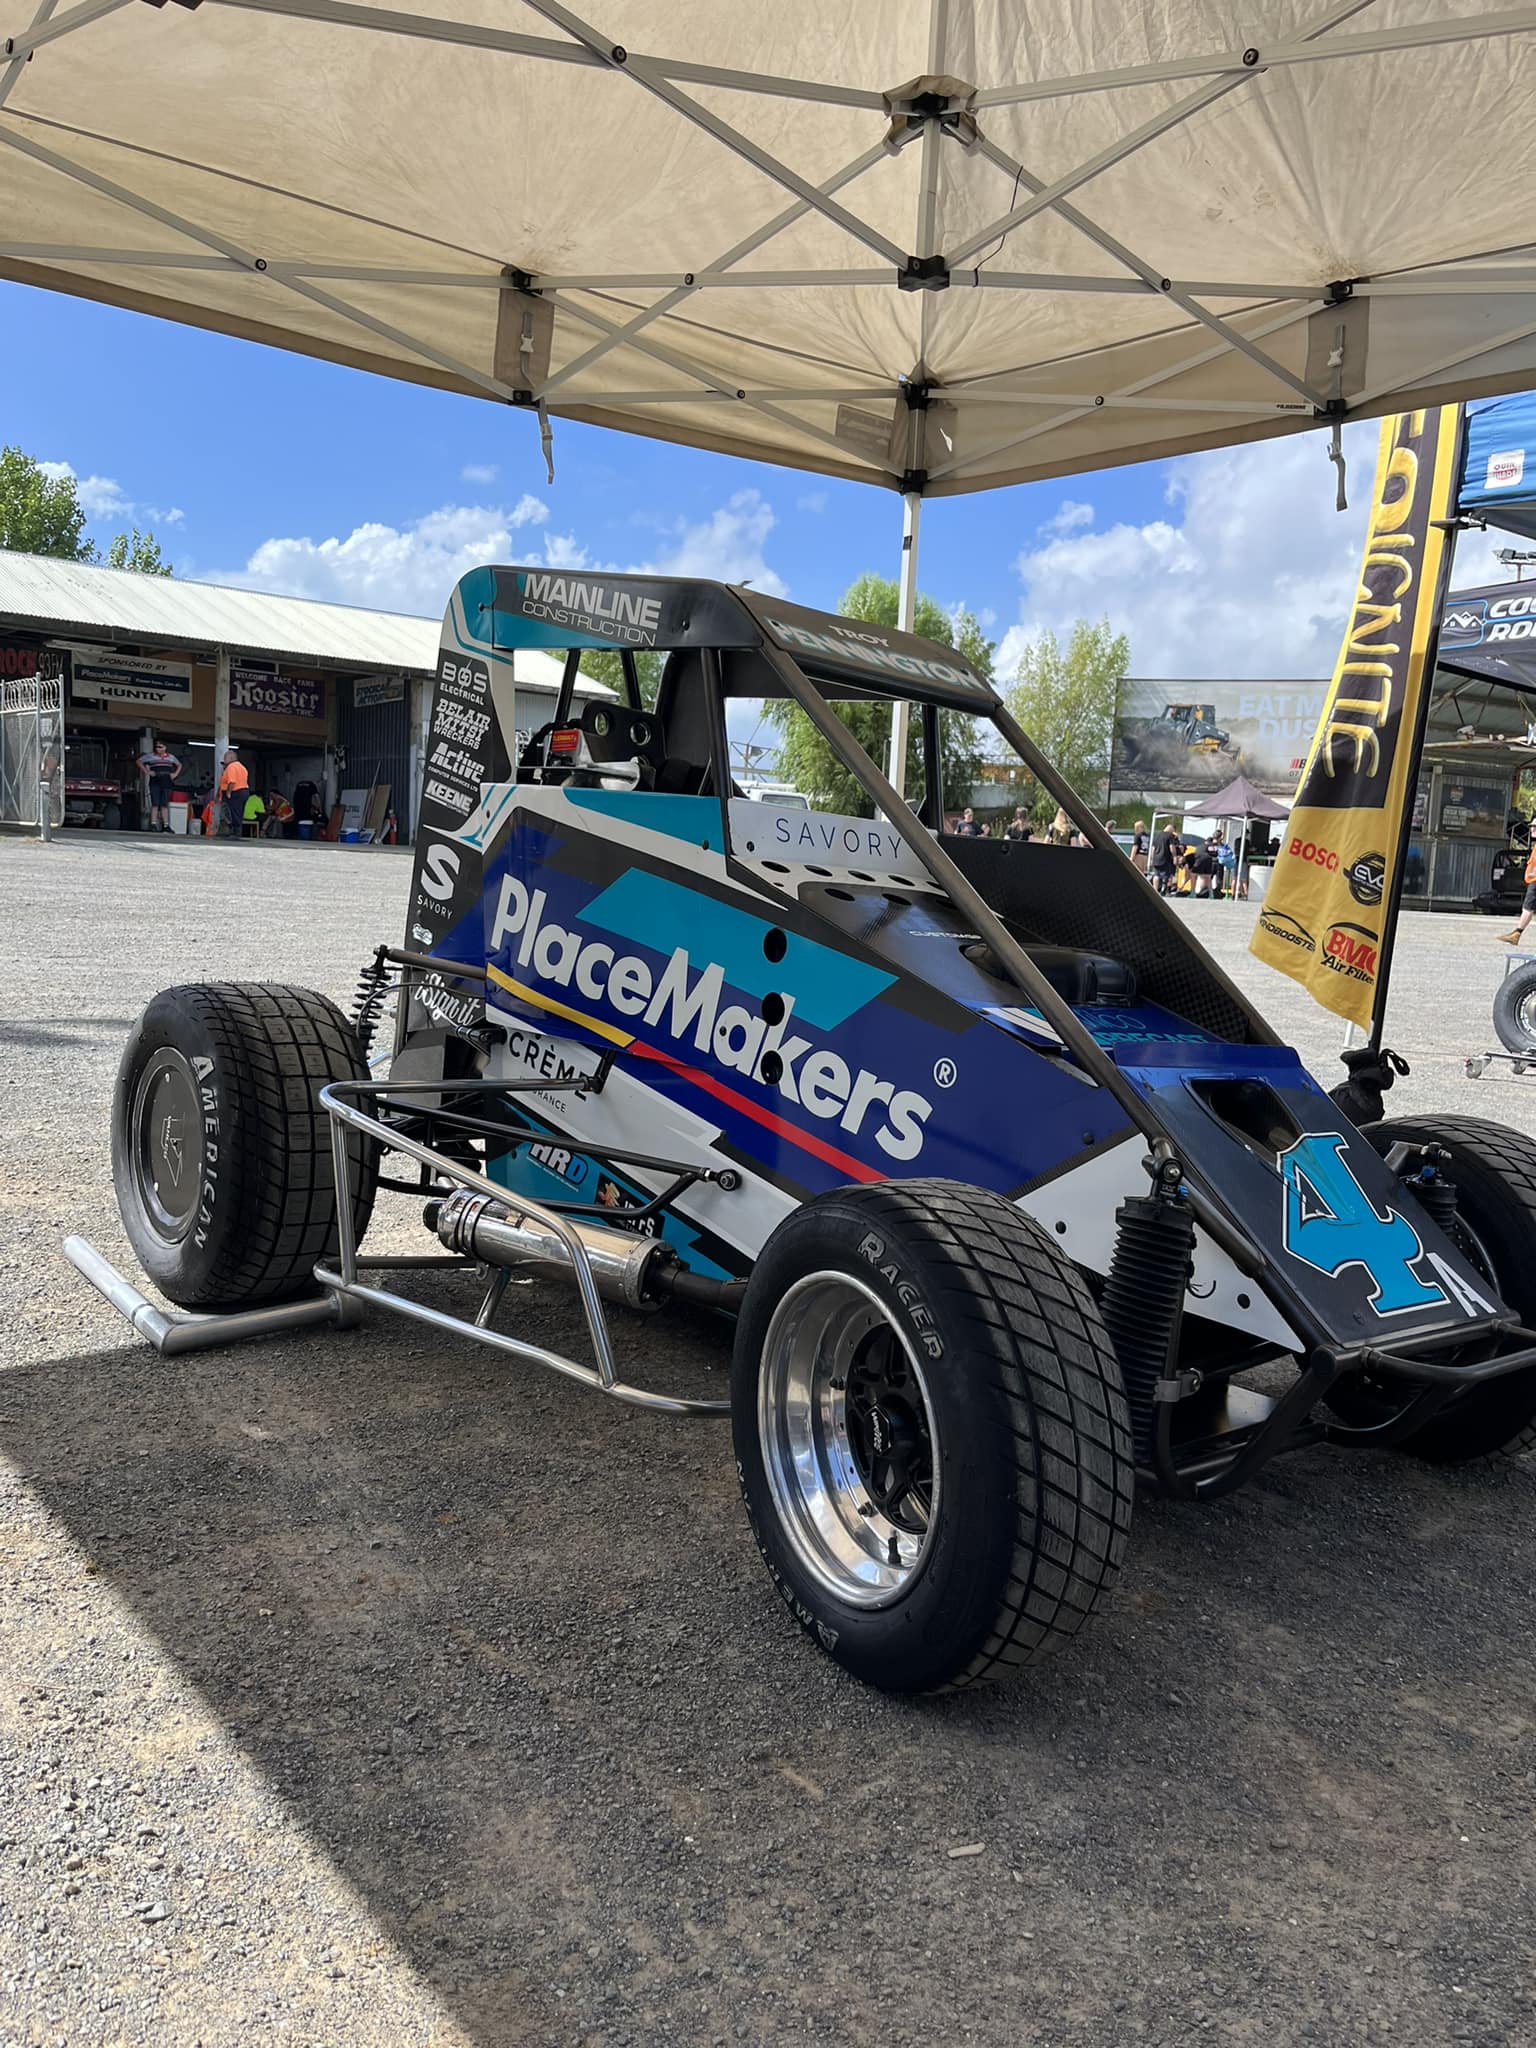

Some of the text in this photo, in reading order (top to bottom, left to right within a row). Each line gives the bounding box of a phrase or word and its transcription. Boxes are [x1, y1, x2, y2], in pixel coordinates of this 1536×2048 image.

[524, 573, 662, 630] MAINLINE
[522, 601, 656, 647] CONSTRUCTION
[829, 625, 890, 648] TROY
[764, 616, 990, 692] PENNINGTON
[100, 687, 166, 702] HUNTLY
[230, 681, 320, 711] Hoosier
[440, 682, 484, 706] ELECTRICAL
[1239, 695, 1322, 718] EAT M
[435, 712, 484, 743] MITSI
[436, 698, 491, 731] BELAIR
[1258, 719, 1317, 740] DUS
[433, 720, 480, 750] WRECKERS
[430, 741, 485, 784] Active
[425, 779, 474, 813] KEENE
[775, 818, 902, 859] SAVORY
[417, 894, 453, 920] SAVORY
[1320, 955, 1346, 972] Air
[490, 873, 934, 1161] PlaceMakers
[190, 1055, 221, 1250] AMERICAN
[1276, 1131, 1498, 1318] 4 A
[856, 1230, 946, 1360] RACER
